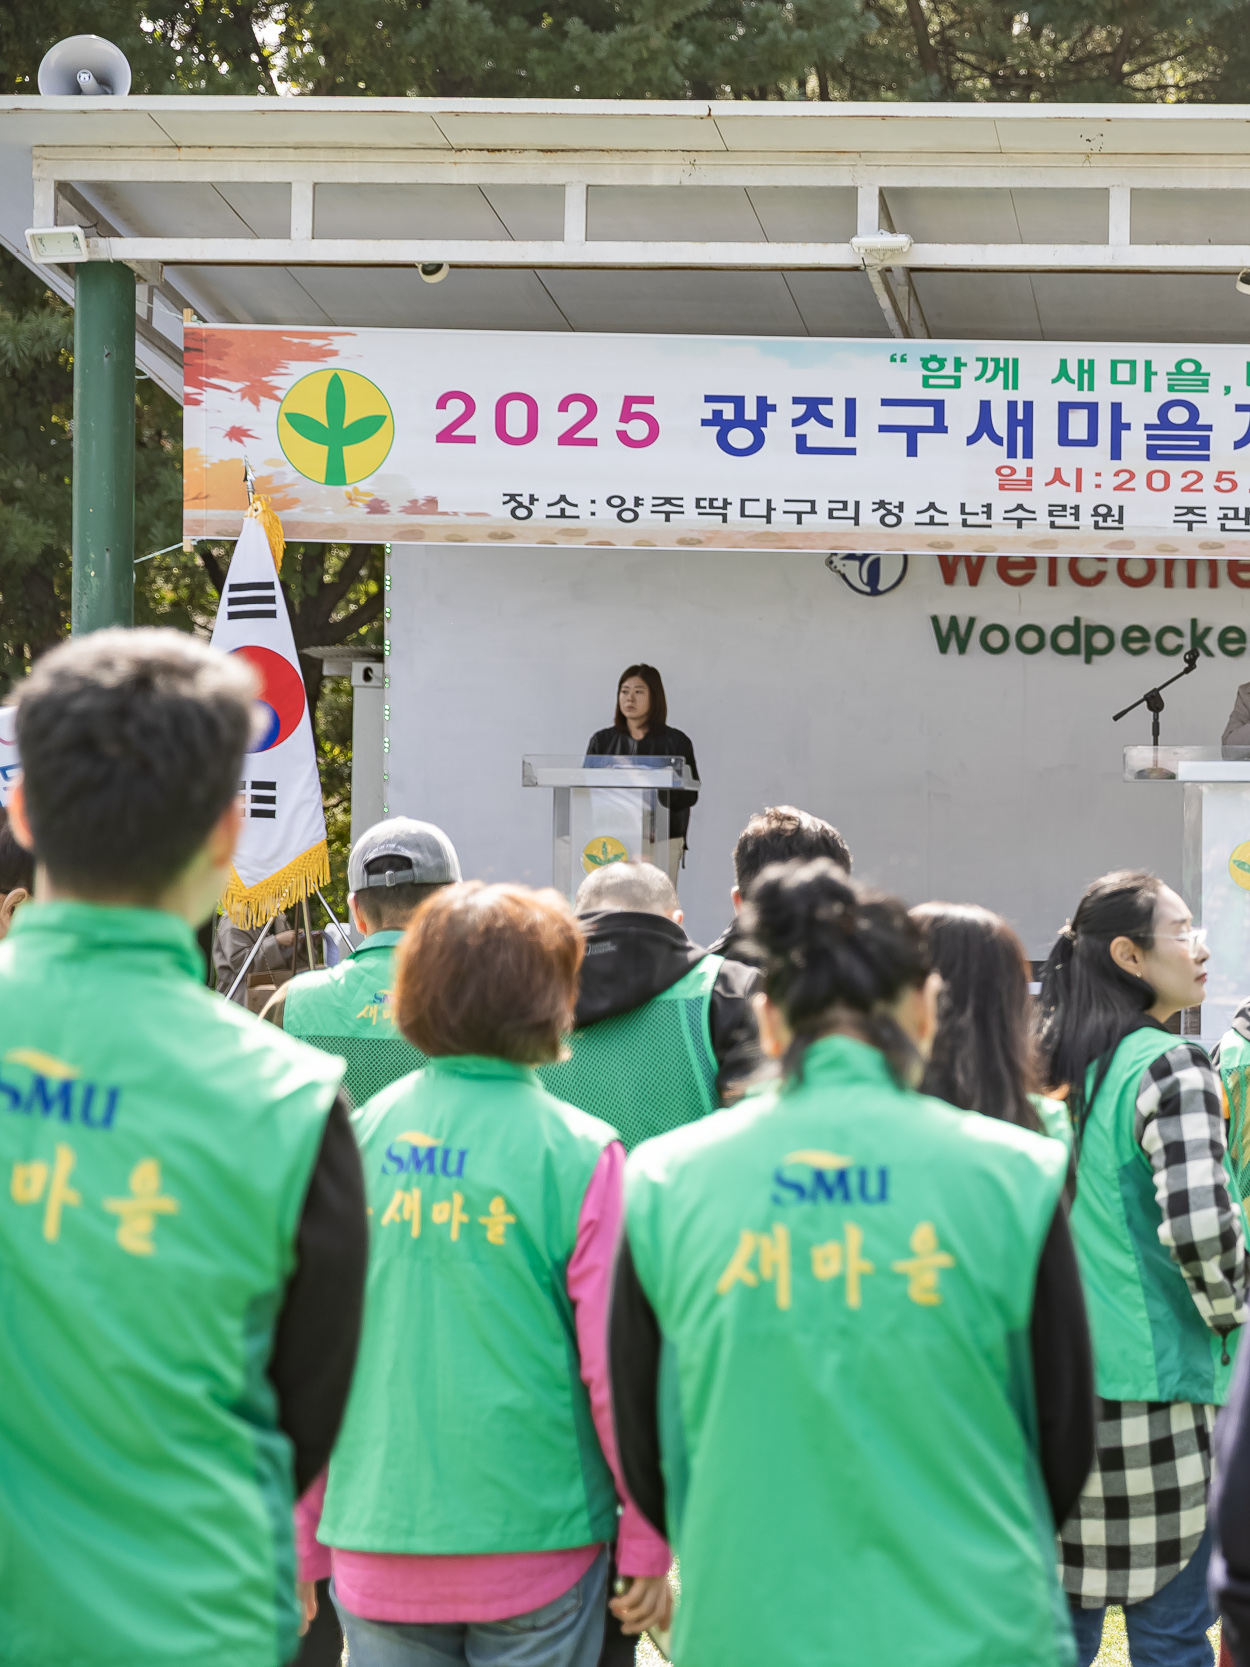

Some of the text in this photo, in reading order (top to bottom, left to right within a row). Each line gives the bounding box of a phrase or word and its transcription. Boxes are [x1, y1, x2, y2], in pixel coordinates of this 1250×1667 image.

[435, 390, 660, 449] 2025
[502, 493, 1125, 531] 장소:양주딱다구리청소년수련원
[380, 1142, 469, 1180] SMU
[770, 1163, 891, 1208] SMU
[380, 1187, 517, 1246] 새마을
[716, 1220, 956, 1311] 새마을
